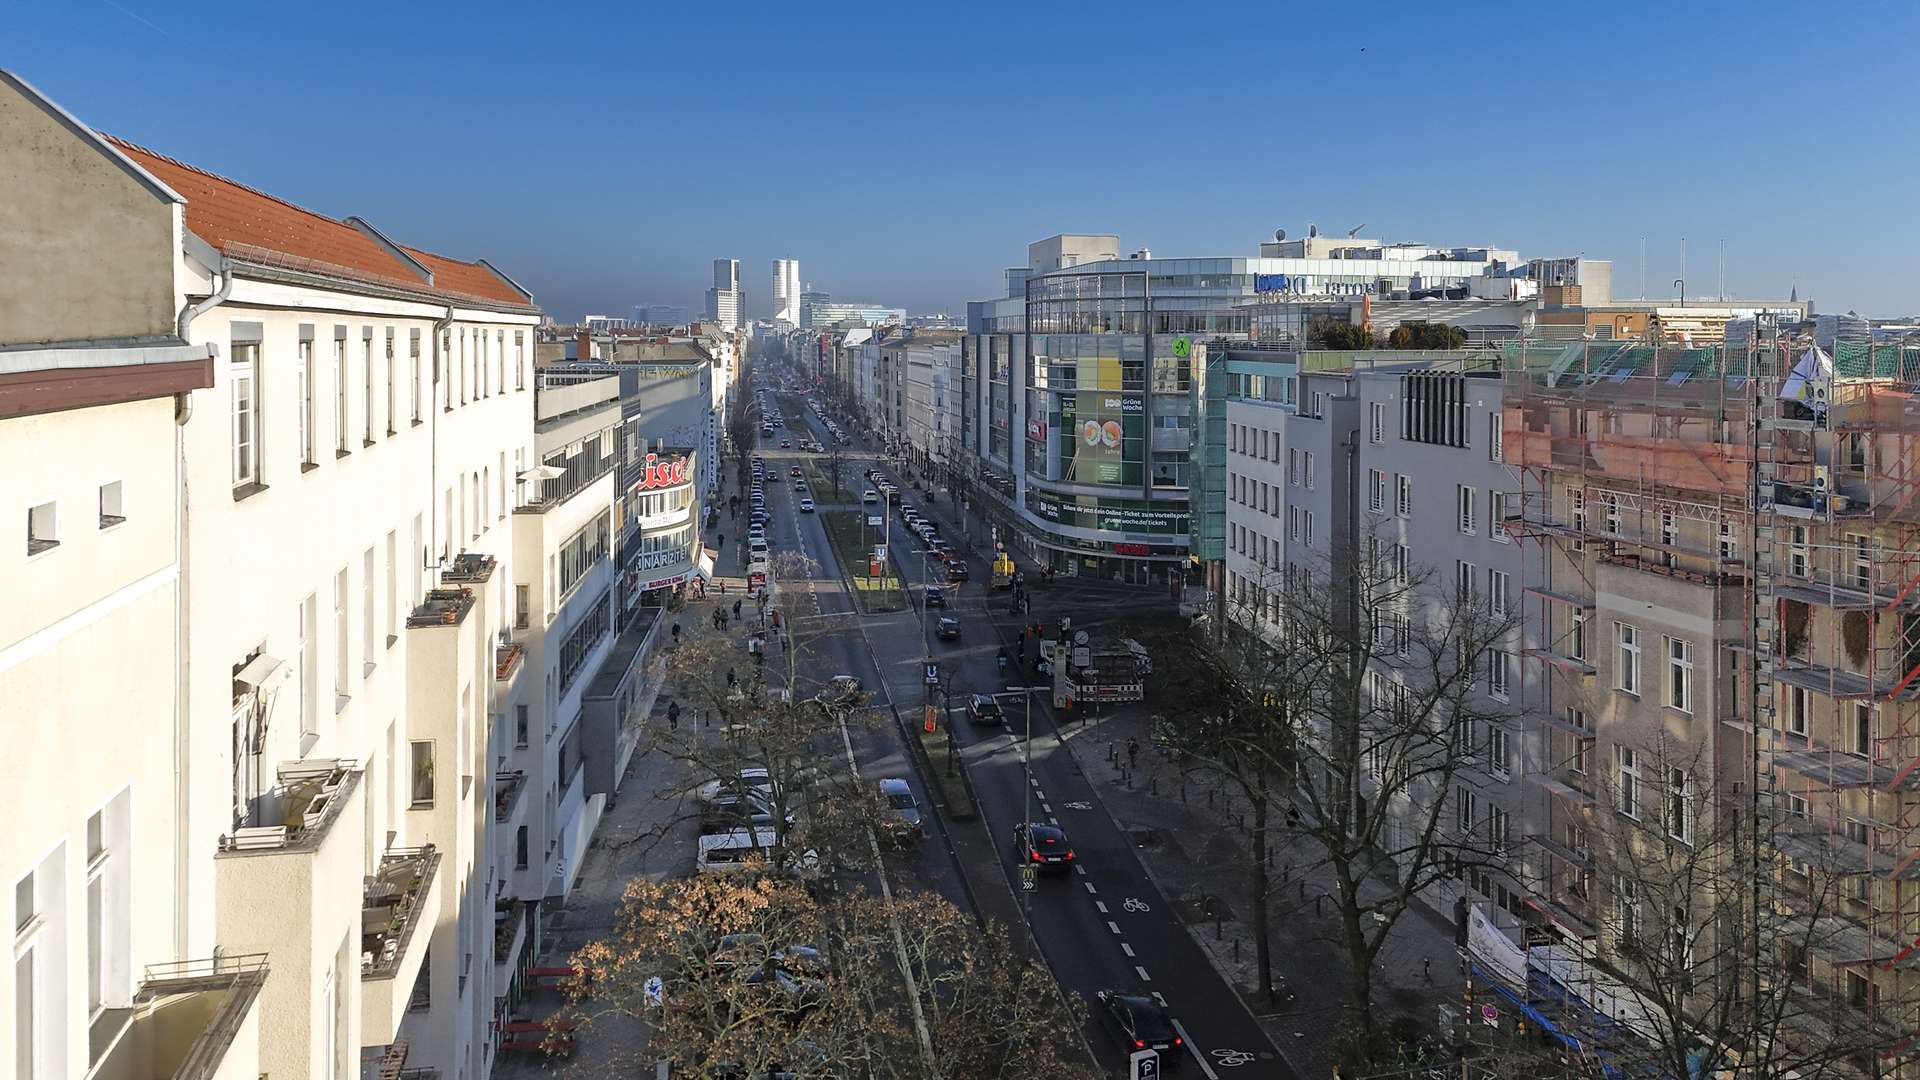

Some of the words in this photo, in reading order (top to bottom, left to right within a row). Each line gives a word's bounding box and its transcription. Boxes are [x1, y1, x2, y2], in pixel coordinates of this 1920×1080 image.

[1105, 508, 1140, 518] Online-Ticket
[877, 548, 885, 556] U
[648, 578, 672, 589] BURGER
[927, 665, 937, 677] U
[1144, 1064, 1152, 1076] P
